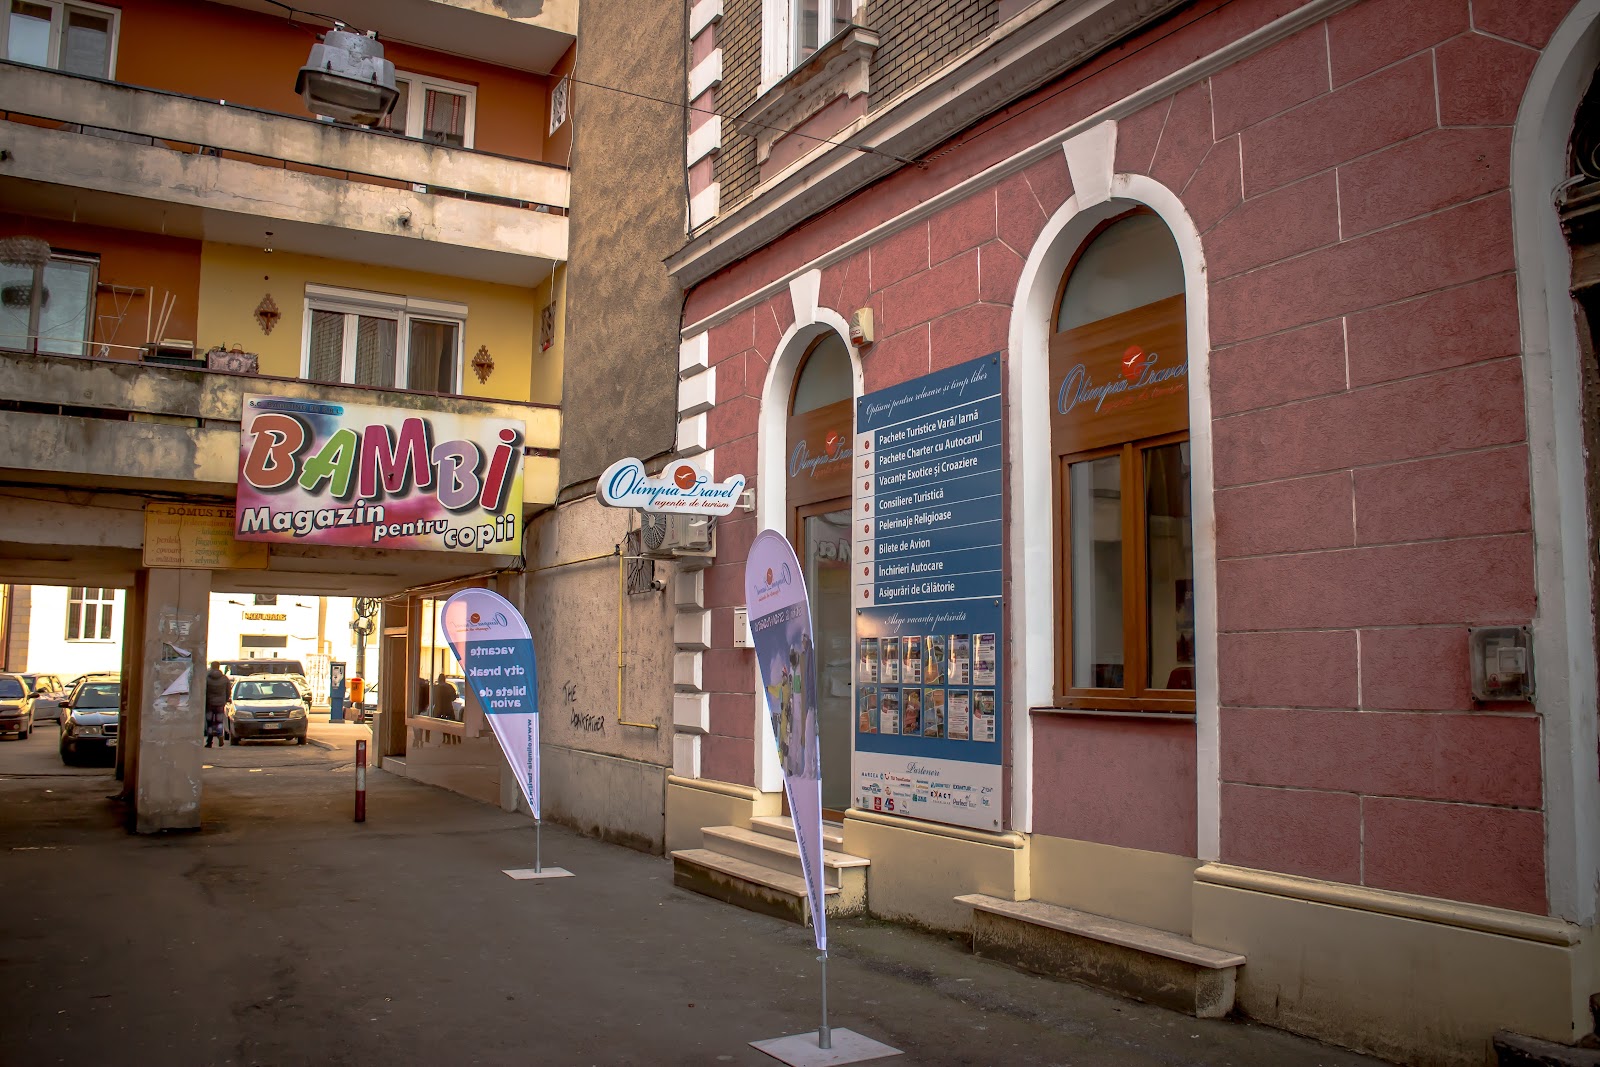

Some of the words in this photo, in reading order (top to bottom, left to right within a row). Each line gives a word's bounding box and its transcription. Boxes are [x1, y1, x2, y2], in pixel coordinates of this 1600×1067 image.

[970, 363, 988, 384] liber
[1057, 363, 1129, 415] Olimpia
[879, 431, 906, 445] Pachete
[906, 421, 937, 438] Turistice
[958, 409, 979, 424] Iarnă
[879, 451, 906, 466] Pachete
[906, 445, 934, 459] Charter
[934, 442, 944, 452] cu
[945, 430, 983, 450] Autocarul
[879, 471, 906, 486] Vacanțe
[907, 465, 933, 480] Exotice
[934, 461, 941, 478] și
[941, 456, 978, 473] Croaziere
[608, 464, 680, 506] Olimpia
[680, 475, 740, 498] Travel
[701, 500, 730, 508] turism
[879, 495, 913, 510] Consiliere
[913, 488, 945, 503] Turistică
[167, 506, 214, 517] DOMUS
[217, 509, 237, 519] TE
[239, 500, 385, 538] Magazin
[879, 517, 913, 531] Pelerinaje
[914, 510, 952, 526] Religioase
[373, 518, 448, 543] pentru
[444, 514, 516, 551] copii
[879, 542, 899, 554] Bilete
[899, 540, 909, 551] de
[909, 538, 931, 550] Avion
[878, 563, 909, 577] Închirieri
[910, 561, 944, 574] Autocare
[878, 583, 910, 599] Asigurări
[910, 582, 921, 594] de
[921, 580, 955, 593] Călătorie
[562, 679, 577, 706] THE
[930, 790, 951, 799] EXACT
